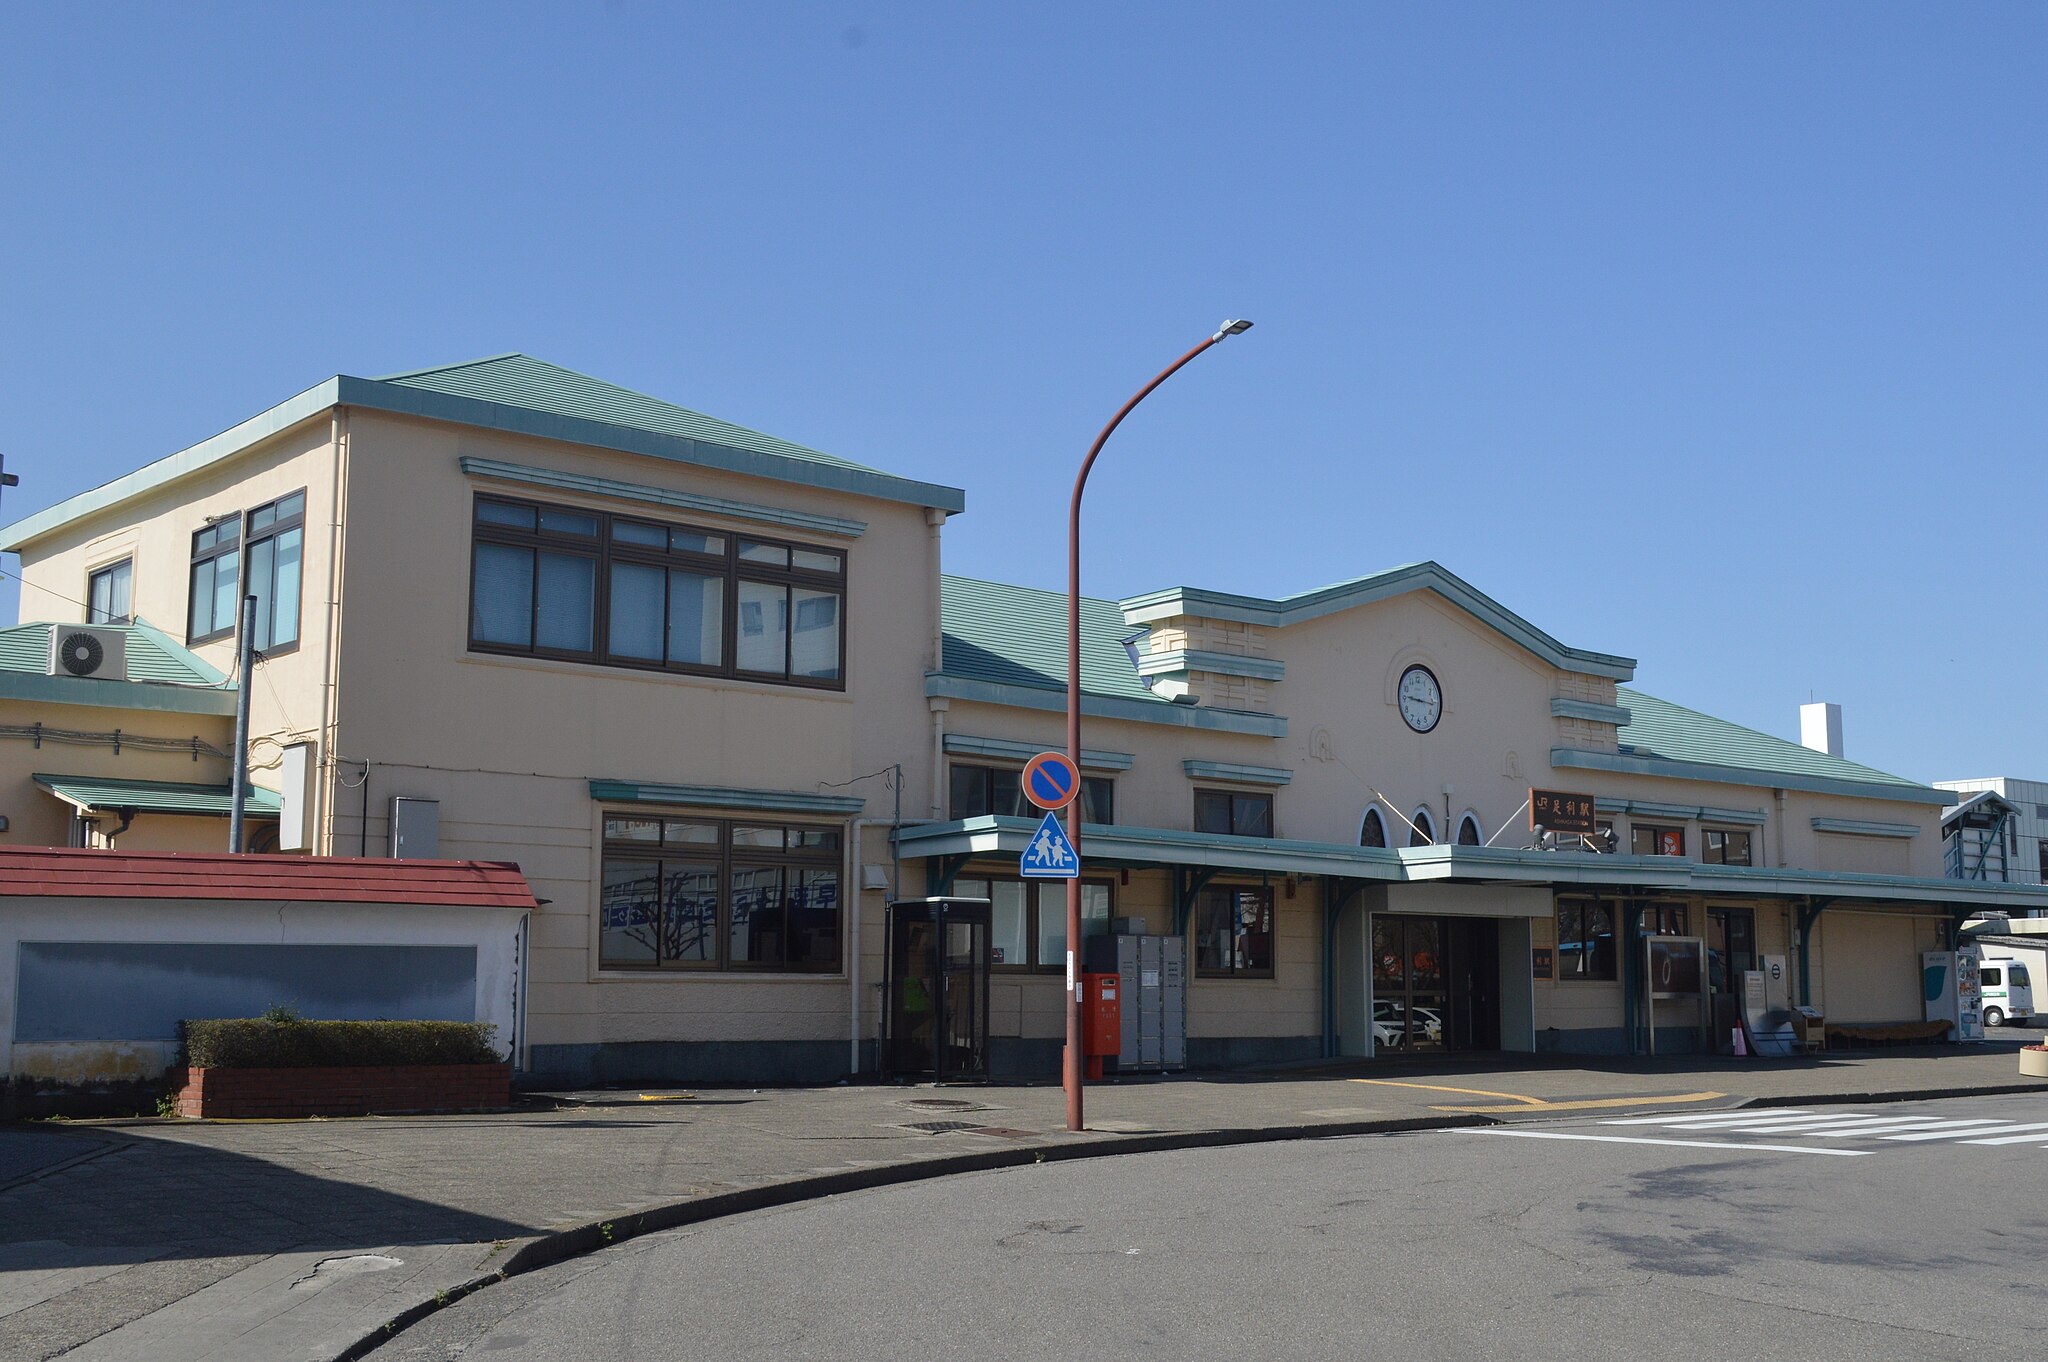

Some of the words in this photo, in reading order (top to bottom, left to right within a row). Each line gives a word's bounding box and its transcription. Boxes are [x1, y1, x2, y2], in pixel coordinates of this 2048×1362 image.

[1537, 797, 1548, 807] JR
[1553, 800, 1590, 816] 足利駅
